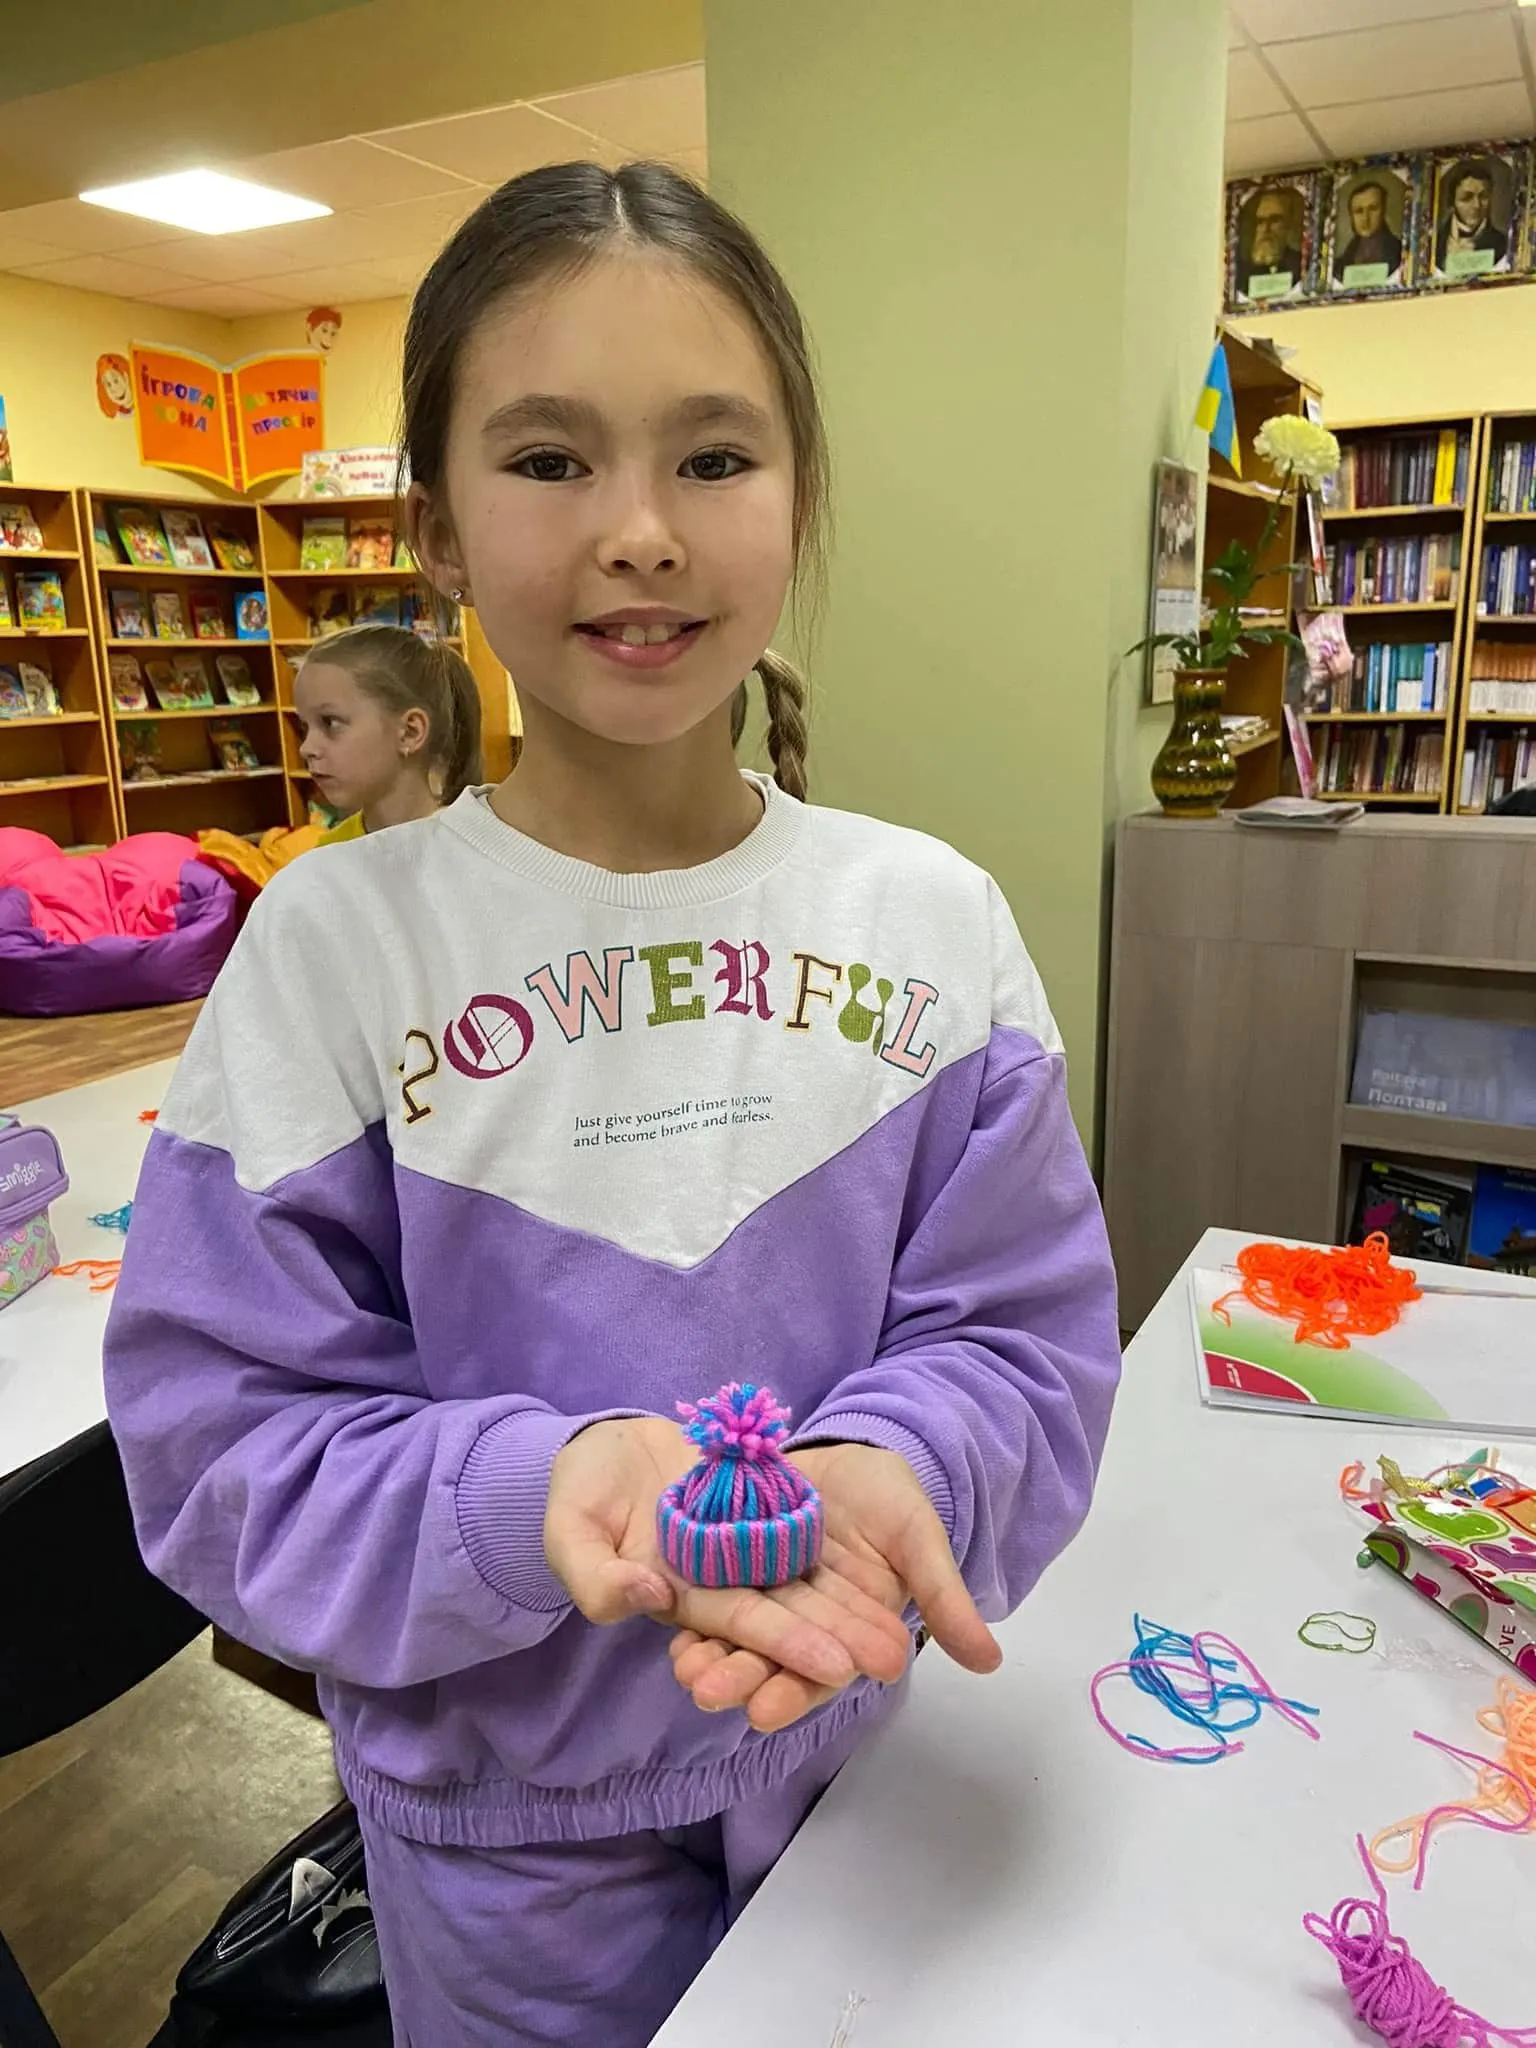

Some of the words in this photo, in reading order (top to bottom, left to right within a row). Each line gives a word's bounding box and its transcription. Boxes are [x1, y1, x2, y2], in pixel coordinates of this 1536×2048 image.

[573, 1132, 600, 1148] and
[605, 1130, 657, 1145] become
[661, 1121, 698, 1138] brave
[702, 1112, 728, 1128] and
[575, 1116, 601, 1131] Just
[605, 1115, 632, 1129] give
[636, 1101, 692, 1127] yourself
[695, 1098, 728, 1113] time
[731, 1096, 741, 1107] to
[742, 1094, 773, 1109] grow
